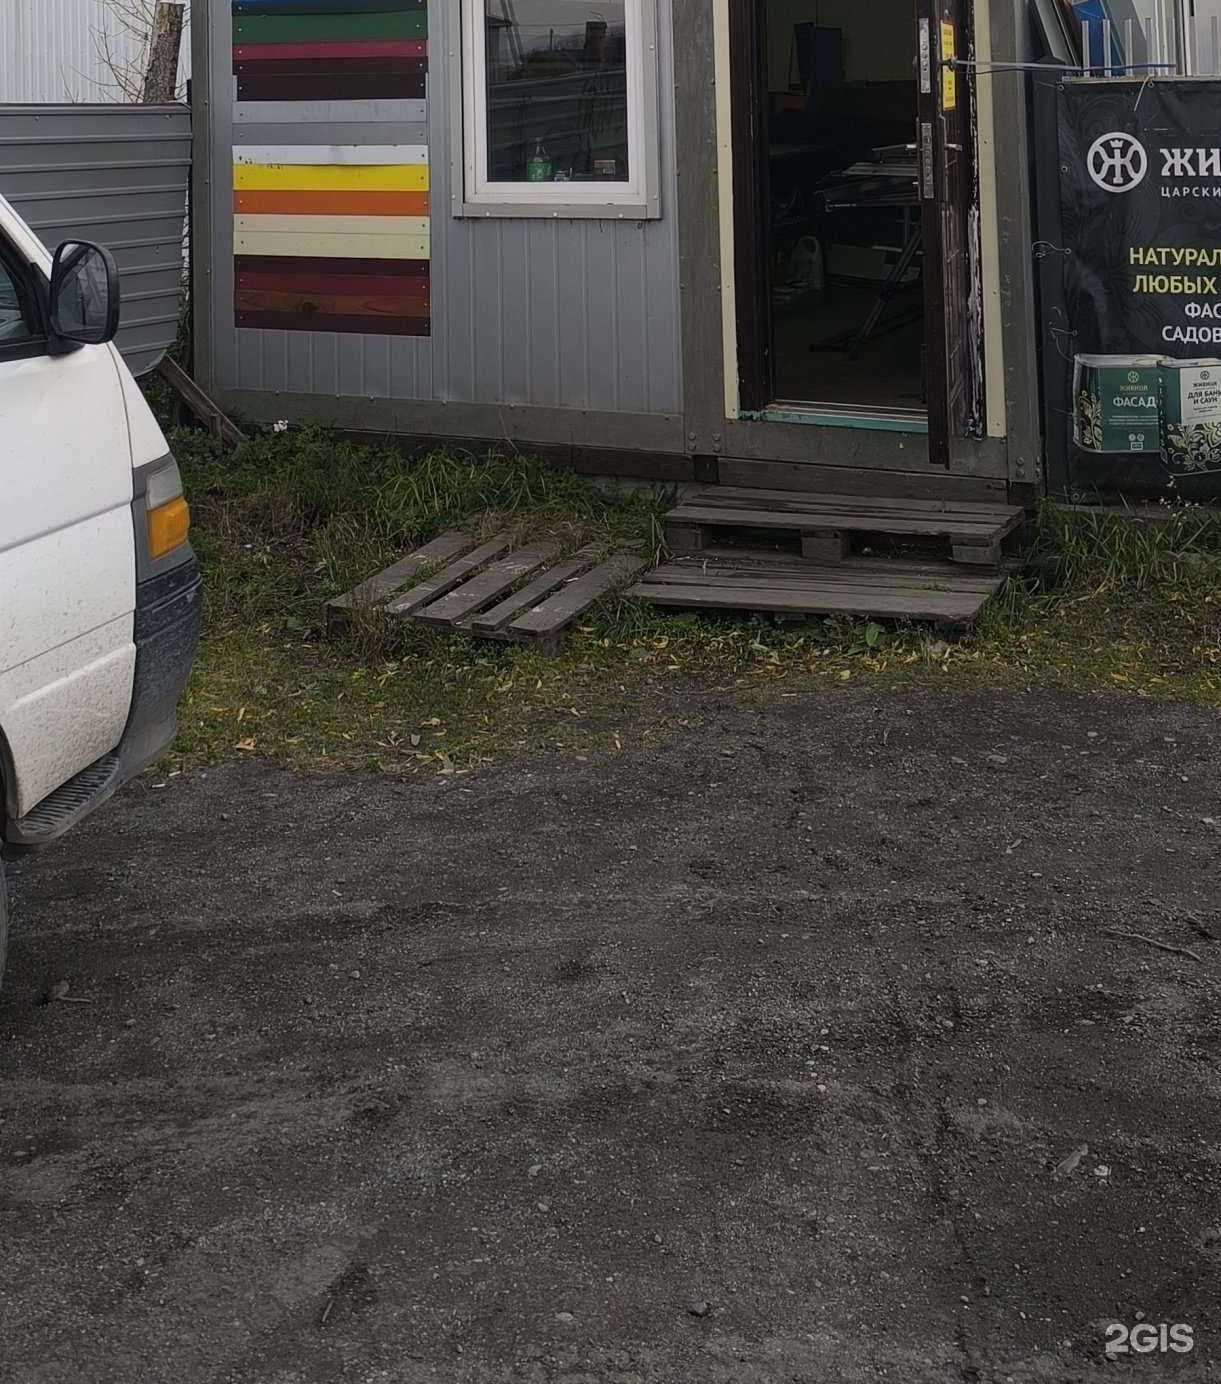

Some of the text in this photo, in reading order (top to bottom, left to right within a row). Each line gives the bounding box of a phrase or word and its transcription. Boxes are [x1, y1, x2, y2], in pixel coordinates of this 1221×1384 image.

[1161, 186, 1221, 198] ЦАРСКИ
[1129, 247, 1221, 267] НАТУРАЛ
[1132, 274, 1218, 295] ЛЮБЫХ
[1184, 302, 1221, 319] ФАС
[1161, 325, 1221, 344] САДОВ
[1112, 396, 1157, 408] ФАСАД
[1188, 391, 1203, 399] ДЛЯ
